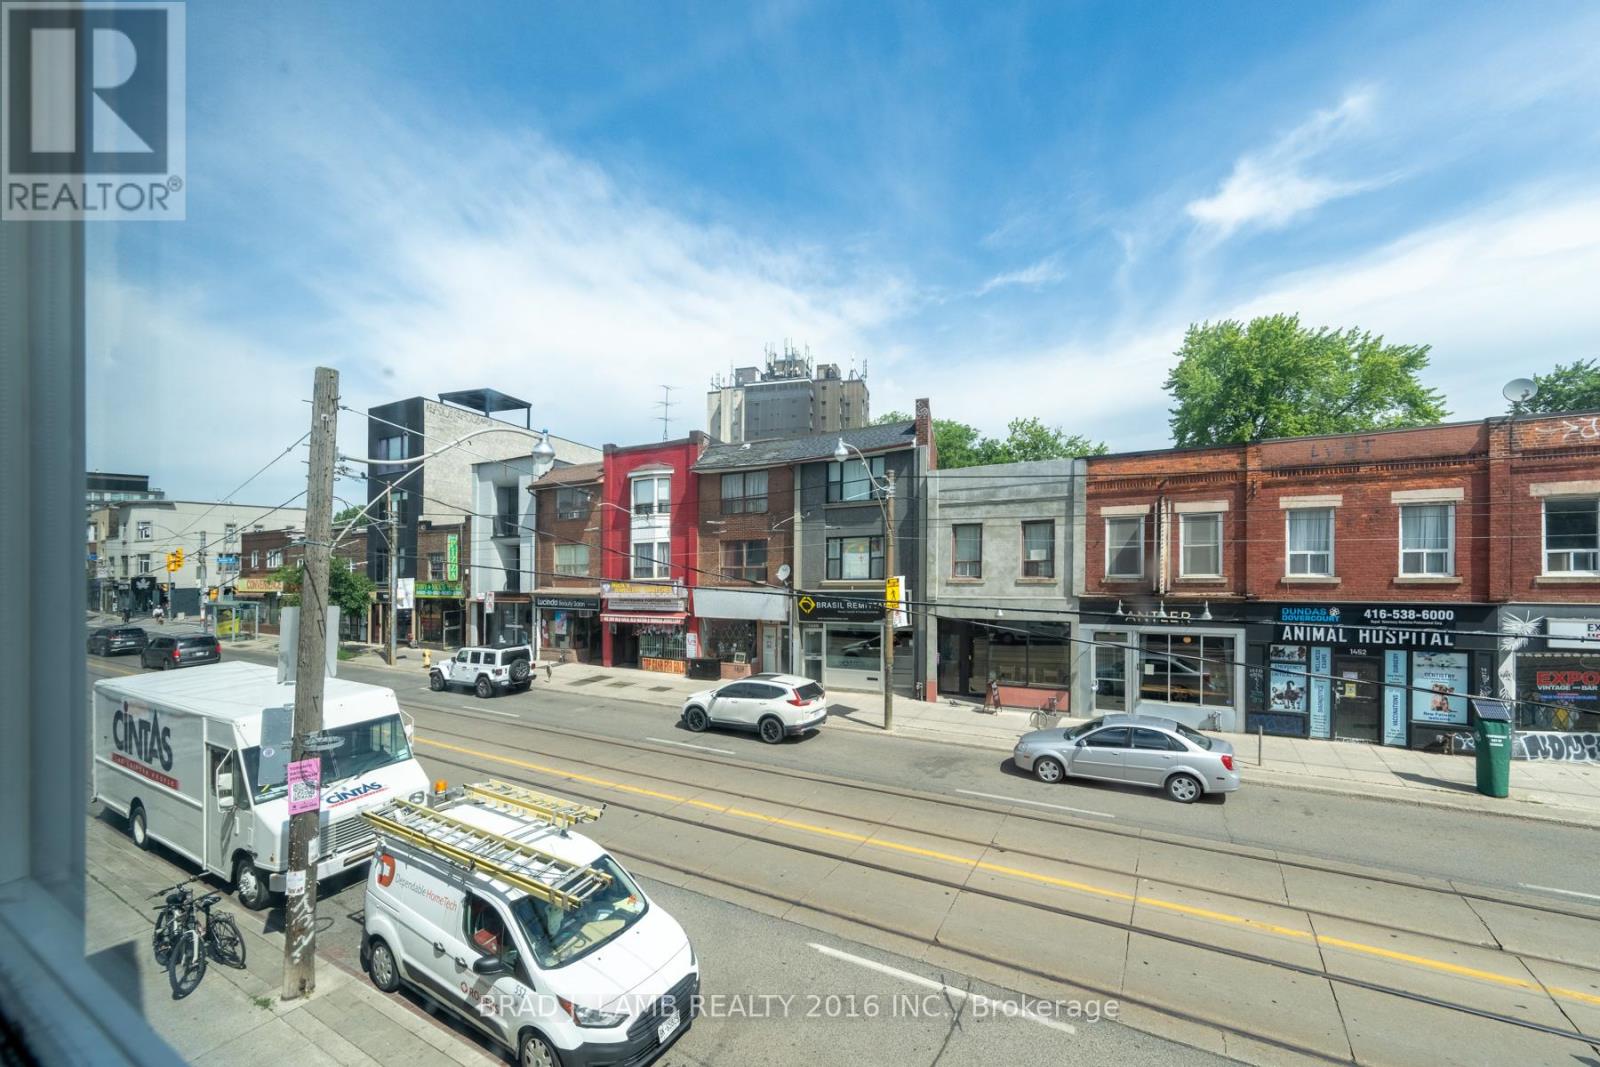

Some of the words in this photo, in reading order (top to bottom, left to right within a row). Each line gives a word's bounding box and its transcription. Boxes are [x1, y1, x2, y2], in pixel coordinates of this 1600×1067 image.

[816, 601, 845, 609] BRASIL
[847, 602, 886, 610] REMITTA
[1281, 607, 1328, 616] DUNDAS
[1364, 609, 1454, 620] 416-538-6000
[1281, 614, 1340, 622] DOVERCOURT
[1282, 626, 1347, 642] ANIMAL
[1359, 629, 1453, 646] HOSPITAL
[1536, 671, 1600, 686] EXPO
